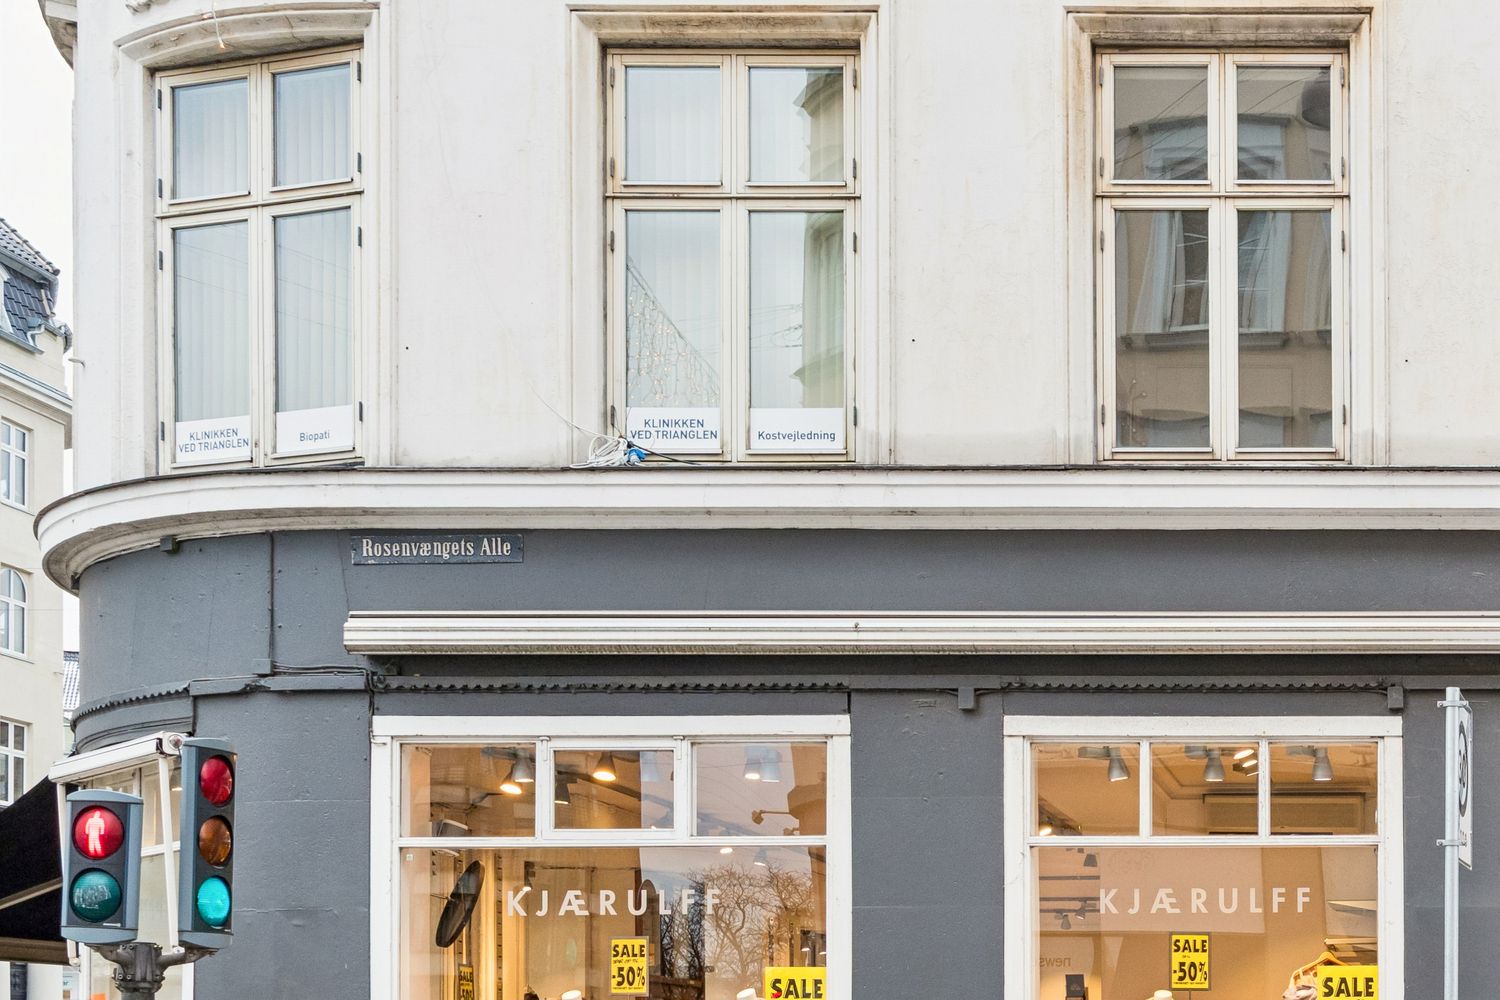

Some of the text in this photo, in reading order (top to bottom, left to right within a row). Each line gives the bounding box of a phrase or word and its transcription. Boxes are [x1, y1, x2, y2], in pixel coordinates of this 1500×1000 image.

[644, 418, 705, 429] KLINIKKEN
[189, 428, 239, 441] KLINIKKEN
[299, 430, 330, 442] Biopati
[630, 430, 718, 440] VED TRIANGLEN
[757, 430, 836, 442] Kostvejledning
[178, 438, 250, 453] VED TRIANGLEN
[362, 537, 512, 560] Rosenvængets Alle
[507, 889, 721, 917] KJÆRULFF
[1100, 887, 1312, 915] KJÆRULFF
[612, 944, 646, 958] SALE
[1173, 939, 1207, 953] SALE
[612, 966, 646, 987] -50%
[1173, 961, 1208, 981] -50%
[770, 978, 823, 999] SALE
[1322, 977, 1375, 997] SALE
